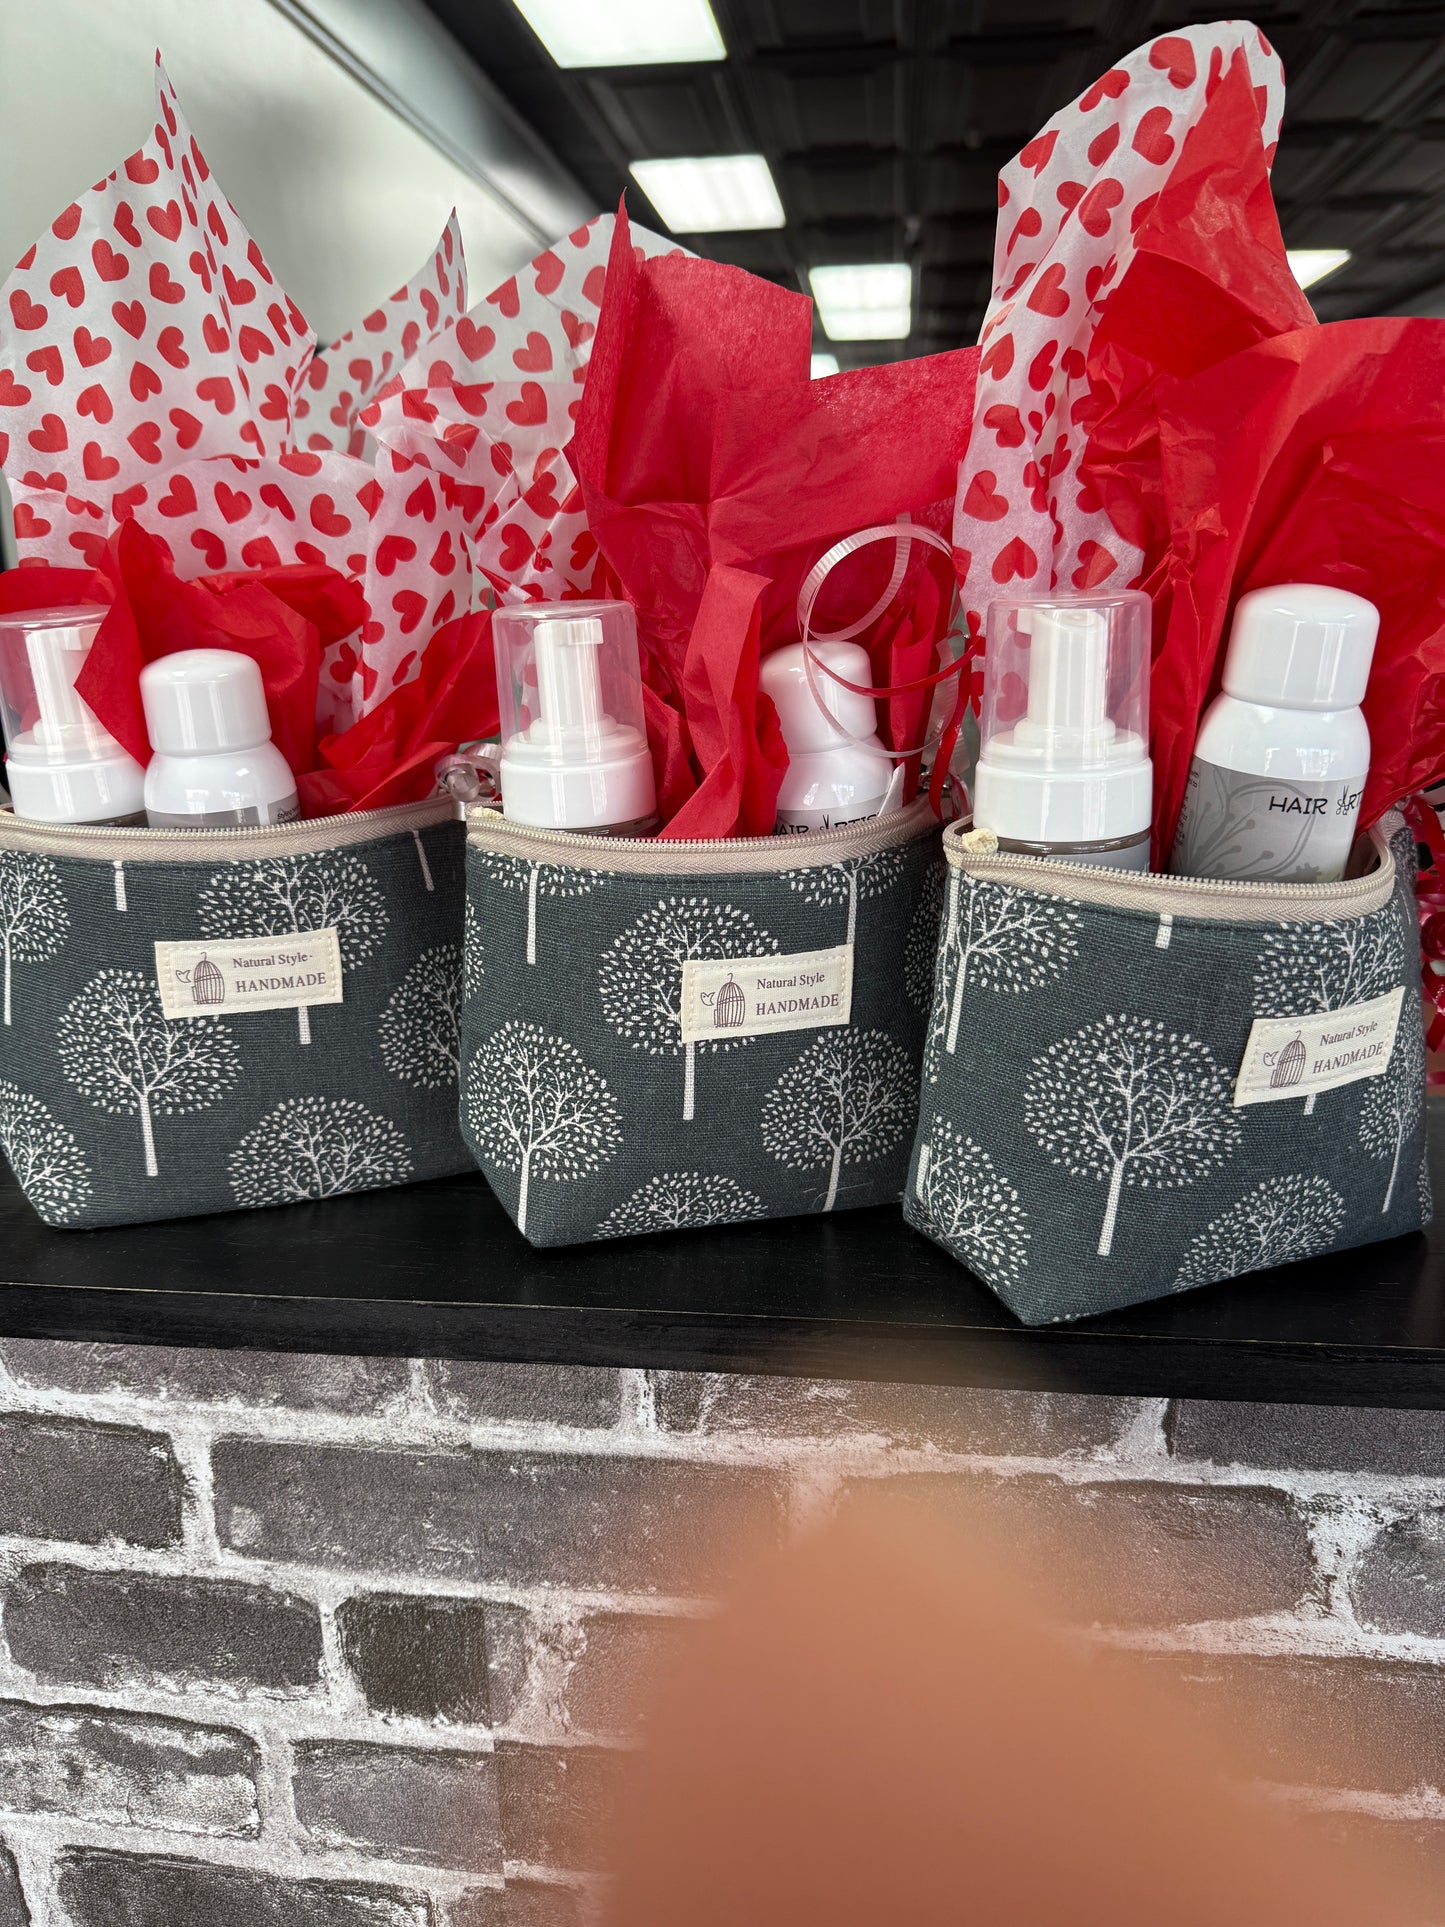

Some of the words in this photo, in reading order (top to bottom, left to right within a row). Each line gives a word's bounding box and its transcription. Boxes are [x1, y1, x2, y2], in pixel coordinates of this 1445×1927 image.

[1268, 796, 1328, 815] HAIR
[233, 955, 275, 968] Natural
[236, 972, 327, 992] HANDMADE
[757, 976, 796, 989] Natural
[799, 972, 825, 987] Style
[756, 994, 839, 1015] HANDMADE
[1320, 1027, 1355, 1046] Natural
[1356, 1021, 1378, 1037] Style
[1313, 1042, 1384, 1073] HANDMADE
